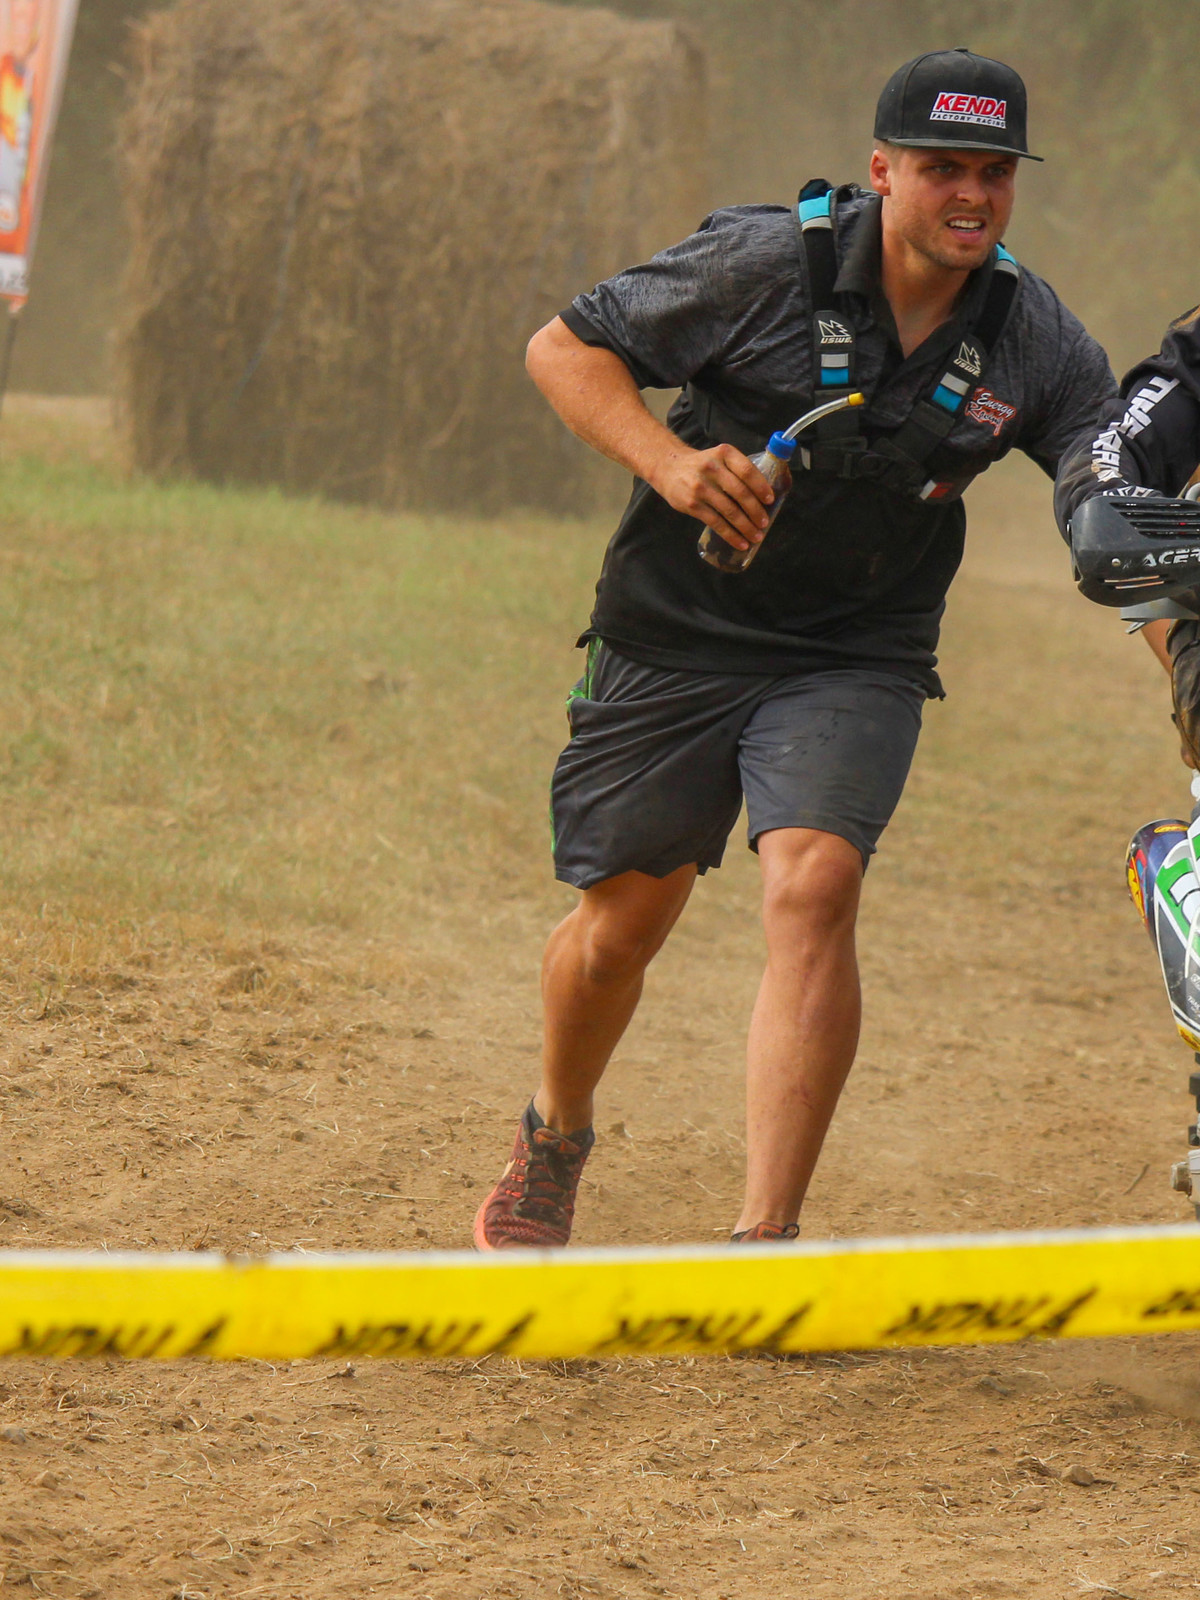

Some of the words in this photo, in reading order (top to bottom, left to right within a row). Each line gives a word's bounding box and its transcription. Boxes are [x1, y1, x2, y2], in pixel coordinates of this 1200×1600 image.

[934, 93, 1006, 119] KENDA
[931, 113, 971, 122] FACTORY
[976, 118, 1006, 128] RACING
[976, 392, 1016, 418] Energy
